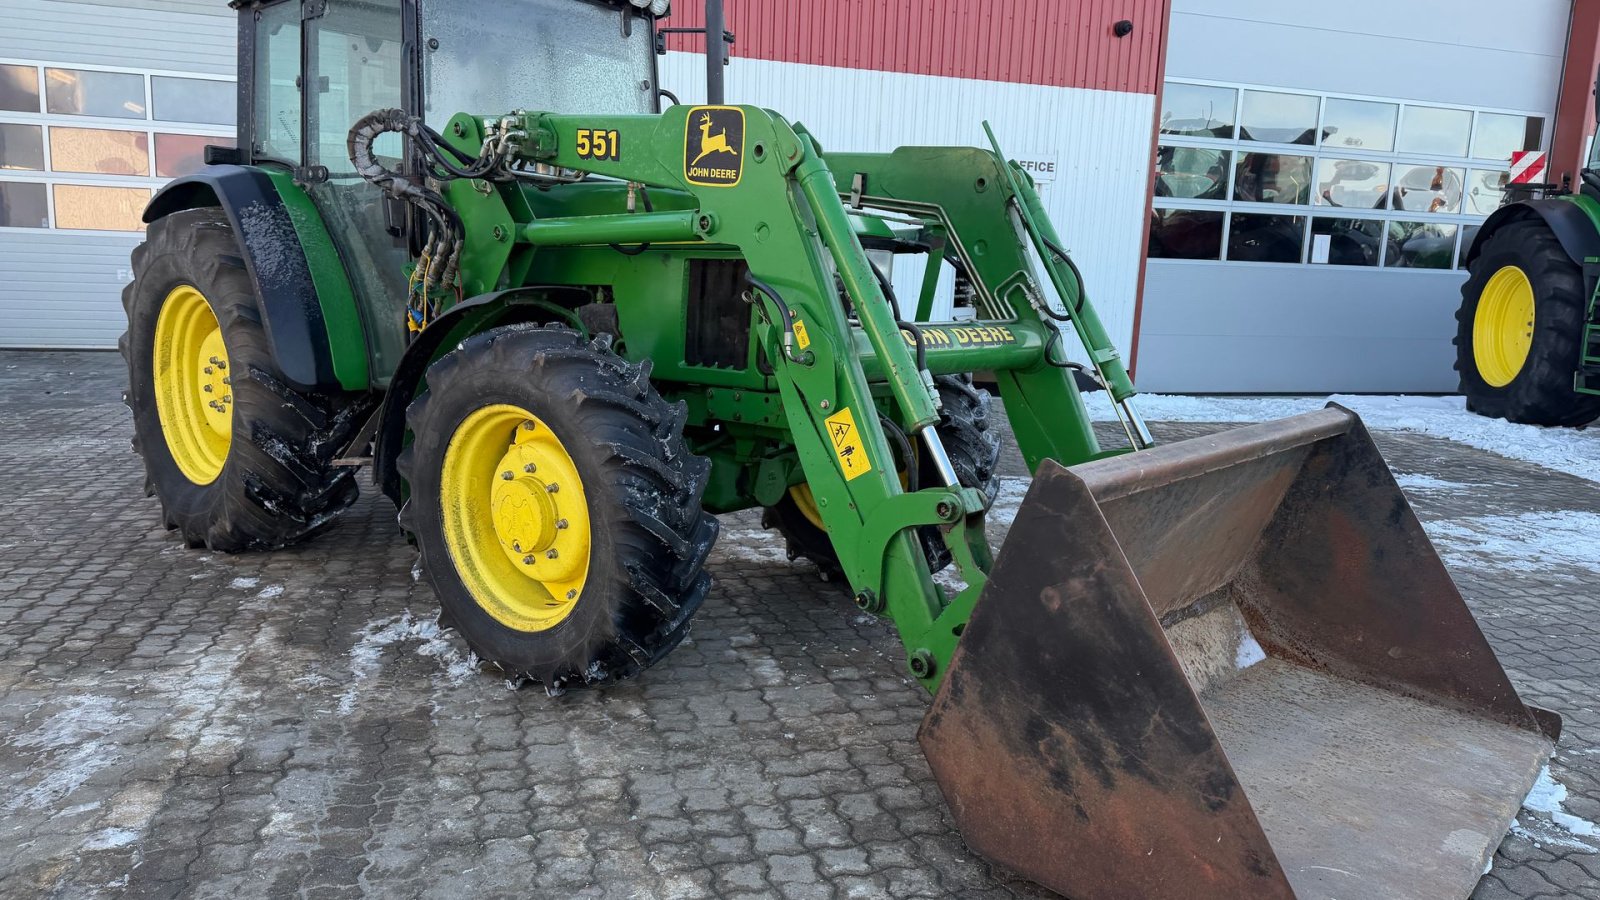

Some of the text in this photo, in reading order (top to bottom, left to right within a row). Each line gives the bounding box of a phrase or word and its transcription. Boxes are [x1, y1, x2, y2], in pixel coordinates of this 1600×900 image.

[576, 129, 619, 161] 551
[688, 167, 737, 179] JOHN DEERE
[1019, 160, 1055, 173] FFICE
[900, 327, 1016, 347] OHN DEERE
